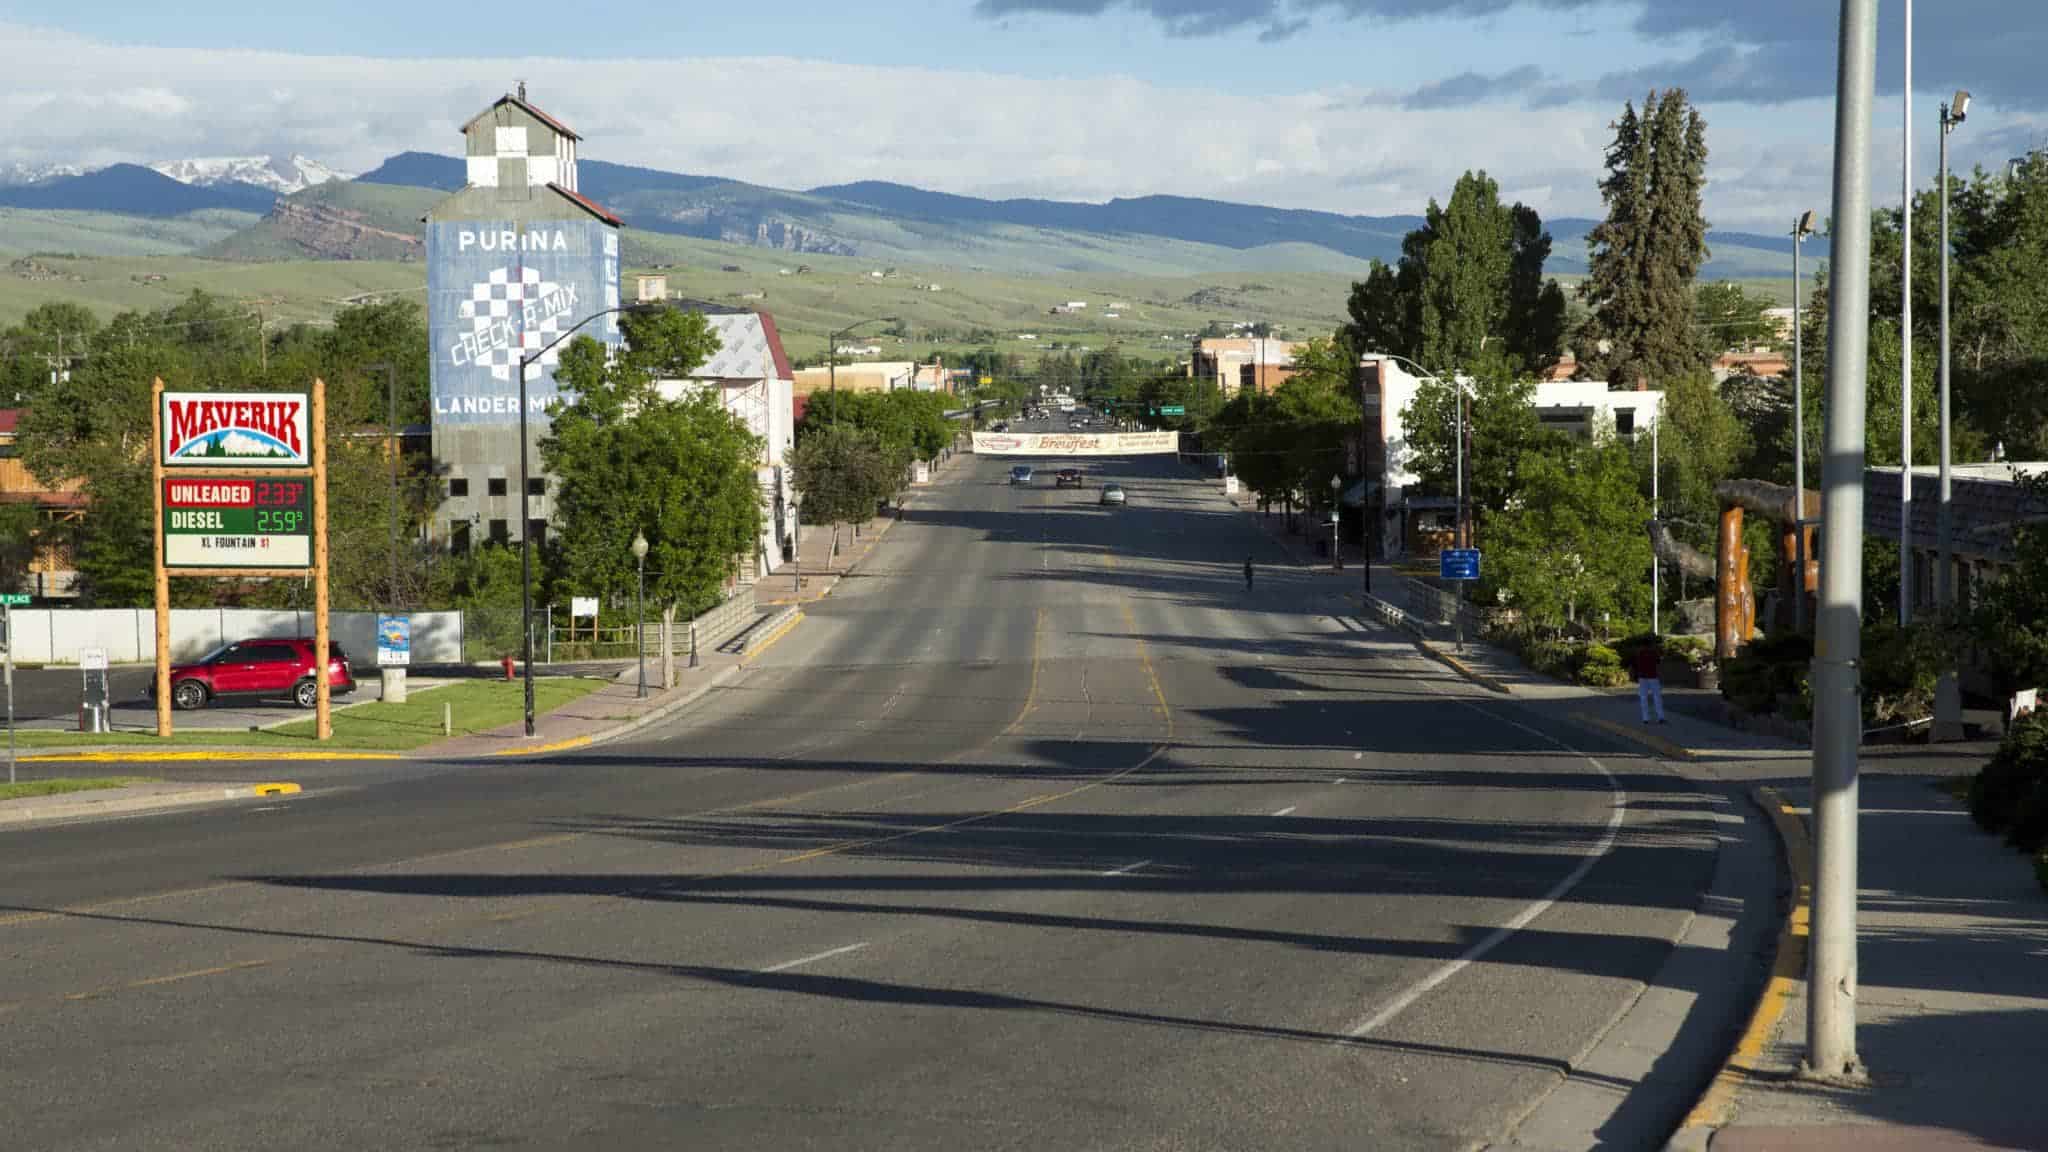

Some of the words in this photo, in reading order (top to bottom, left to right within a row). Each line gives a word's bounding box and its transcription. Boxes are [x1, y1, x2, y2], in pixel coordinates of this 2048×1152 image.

[459, 231, 568, 252] PURINA
[434, 397, 521, 414] LANDER
[168, 400, 302, 456] MAVERIK
[1038, 437, 1101, 454] Brewfest
[171, 485, 251, 503] UNLEADED
[171, 511, 224, 529] DIESEL
[201, 537, 211, 548] XL
[215, 537, 256, 548] FOUNTAIN
